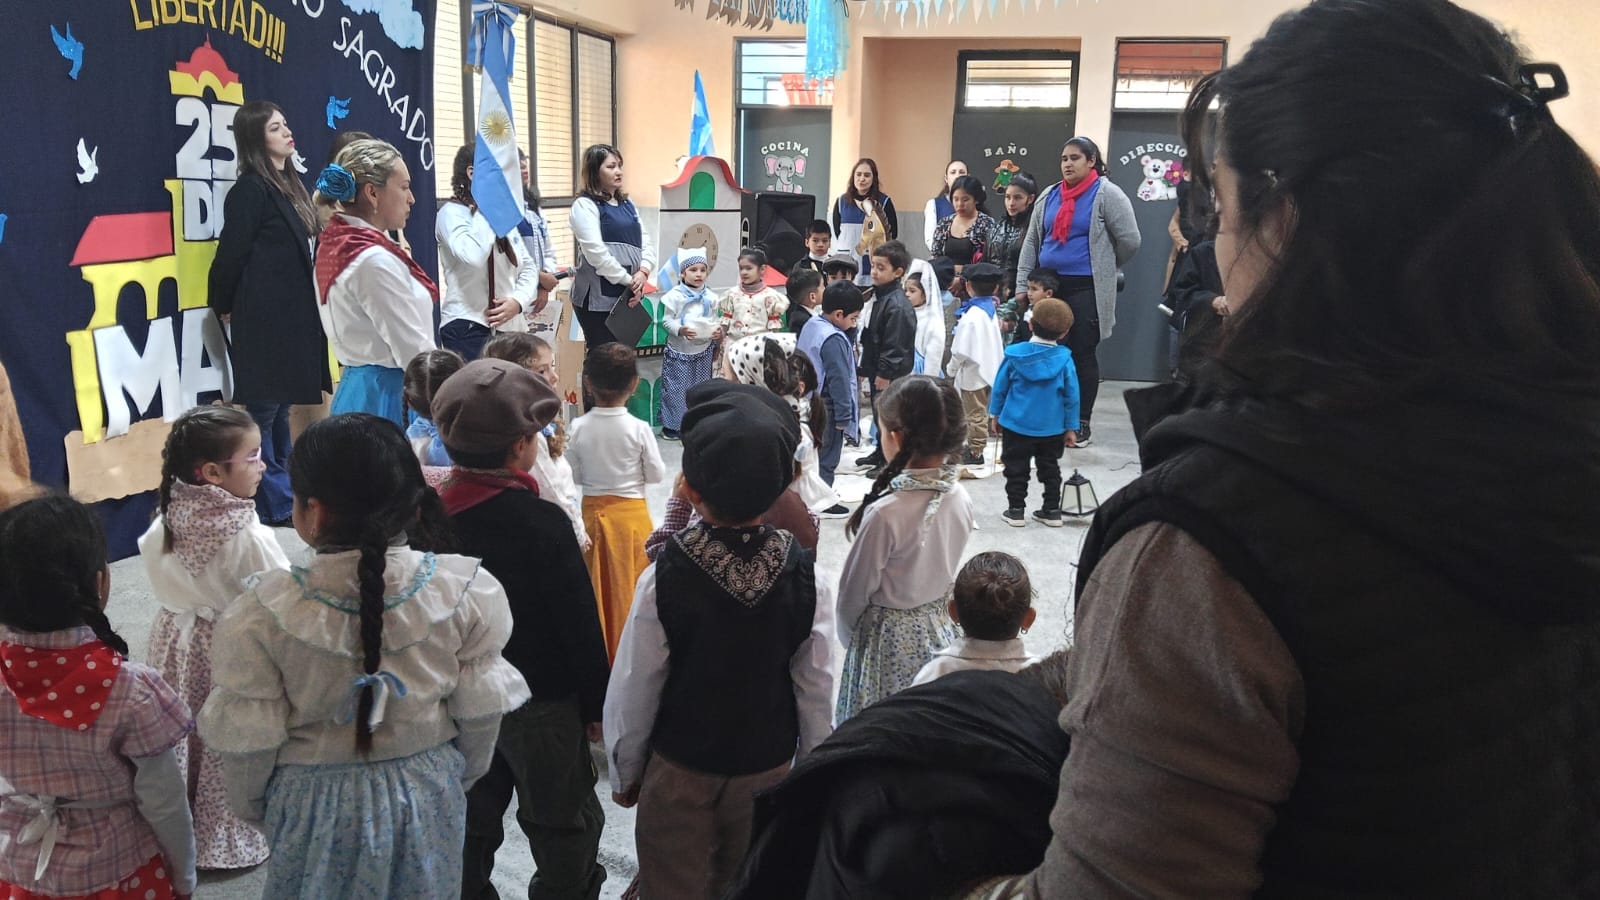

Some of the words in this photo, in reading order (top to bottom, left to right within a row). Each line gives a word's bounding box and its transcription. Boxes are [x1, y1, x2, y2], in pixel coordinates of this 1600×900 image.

[130, 0, 286, 63] LIBERTAD!!!
[175, 97, 238, 181] 25
[761, 141, 809, 157] COCINA
[984, 142, 1028, 157] BAÑO
[1120, 143, 1188, 165] DIRECCIO
